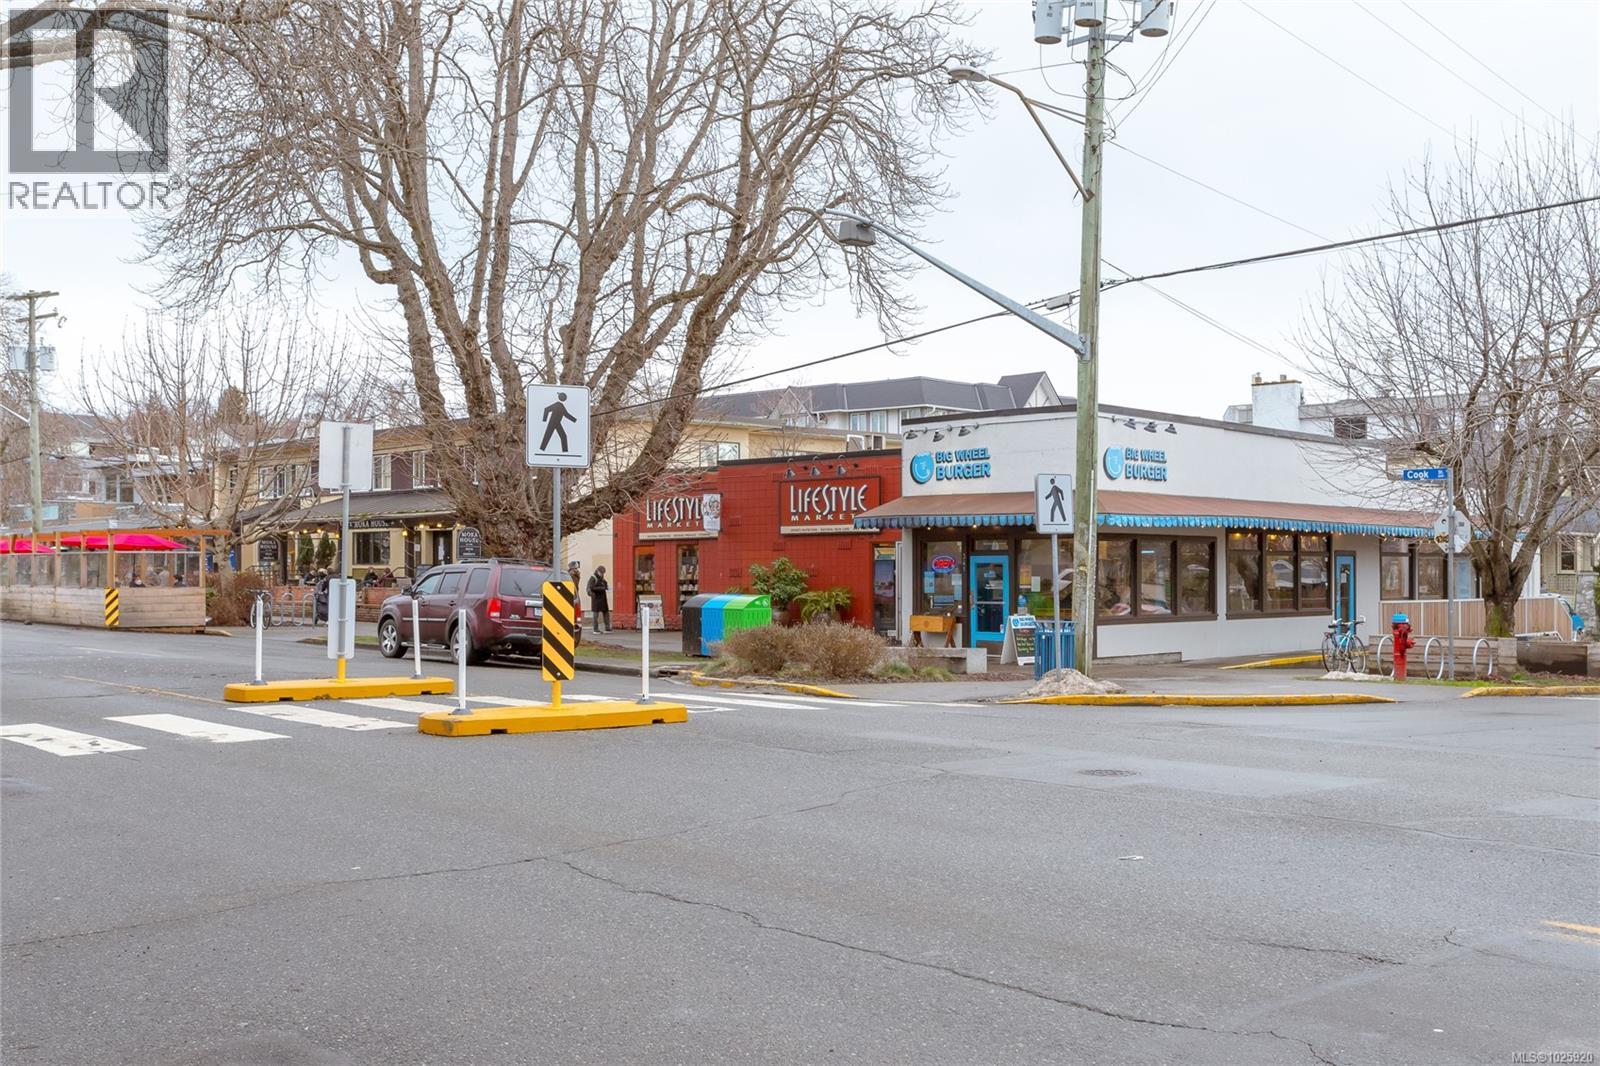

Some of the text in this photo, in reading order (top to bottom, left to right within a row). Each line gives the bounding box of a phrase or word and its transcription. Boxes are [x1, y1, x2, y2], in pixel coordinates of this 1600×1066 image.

[936, 447, 991, 463] BIG WHEEL
[1125, 447, 1140, 461] BIG
[935, 462, 991, 481] BURGER
[1125, 463, 1168, 482] BURGER
[1406, 470, 1429, 479] Cook
[790, 483, 868, 516] LIFESTYLE
[791, 513, 857, 521] MARKET
